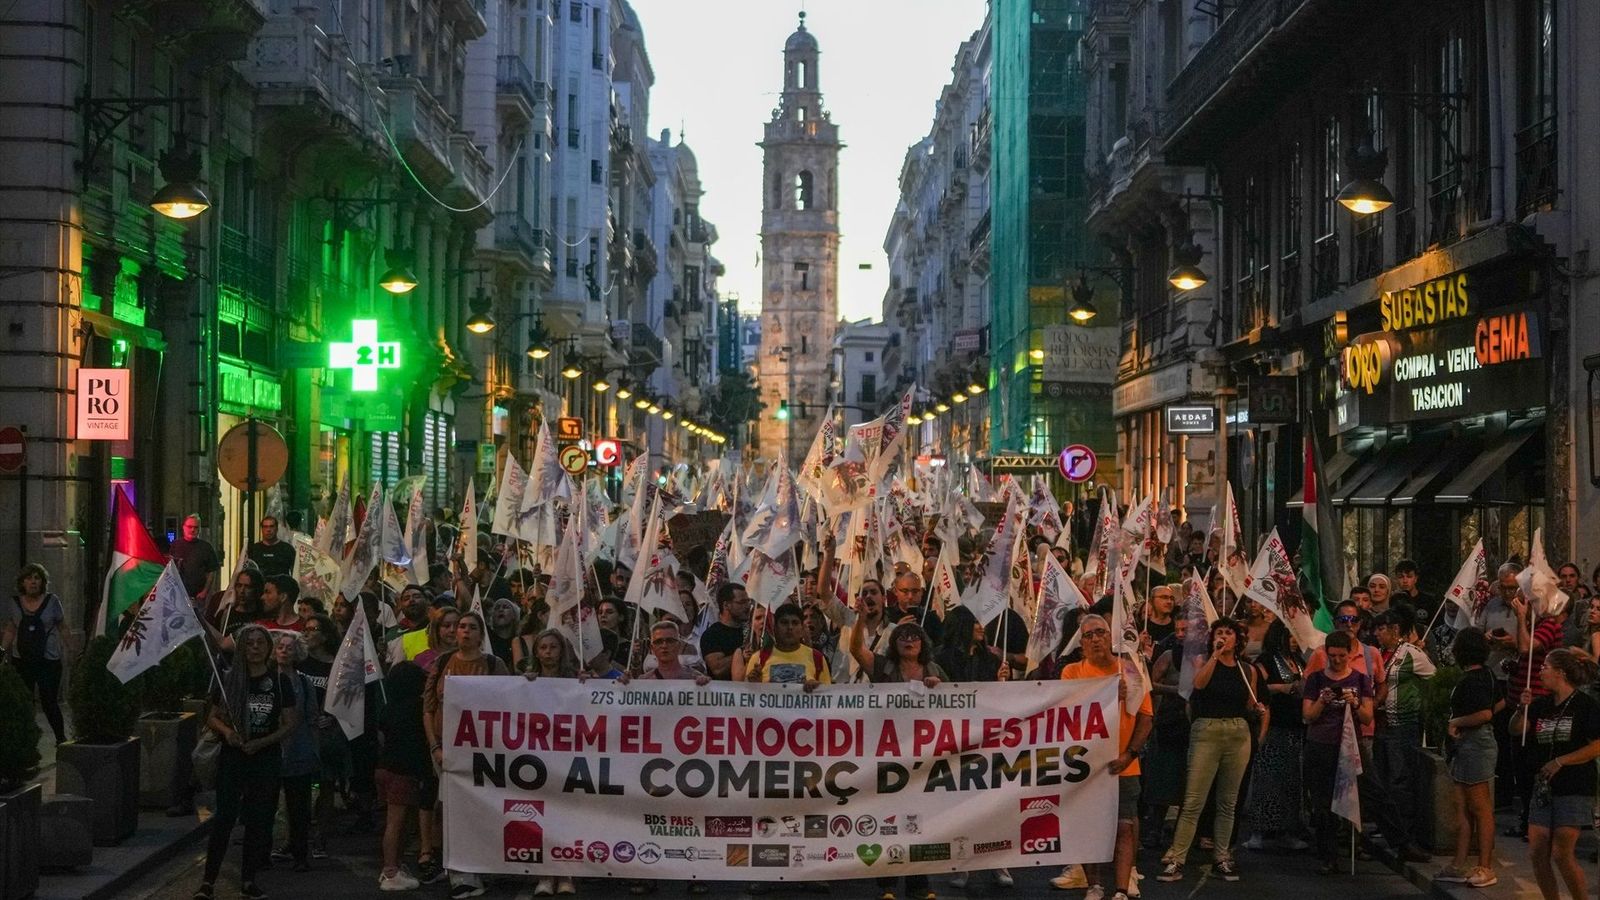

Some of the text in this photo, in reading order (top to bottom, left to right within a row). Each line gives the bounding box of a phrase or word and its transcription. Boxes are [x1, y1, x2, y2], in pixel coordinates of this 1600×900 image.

[1380, 273, 1469, 333] SUBASTAS
[1474, 312, 1530, 367] GEMA
[1349, 339, 1382, 395] ORO
[1394, 353, 1436, 382] COMPRA
[1412, 382, 1463, 412] TASACION
[87, 422, 119, 430] VINTAGE
[1175, 413, 1207, 421] AEDAS
[591, 689, 978, 709] 27S JORNADA DE LLUITA EN SOLIDARITAT AMB EL POBLE PALESTÍ
[453, 701, 1110, 757] ATUREM EL GENOCIDI A PALESTINA
[473, 752, 548, 791] NO
[562, 757, 625, 796] AL
[640, 757, 859, 806] COMERÇ
[644, 814, 667, 825] BDS
[506, 847, 541, 862] CGT
[1023, 838, 1058, 854] CGT
